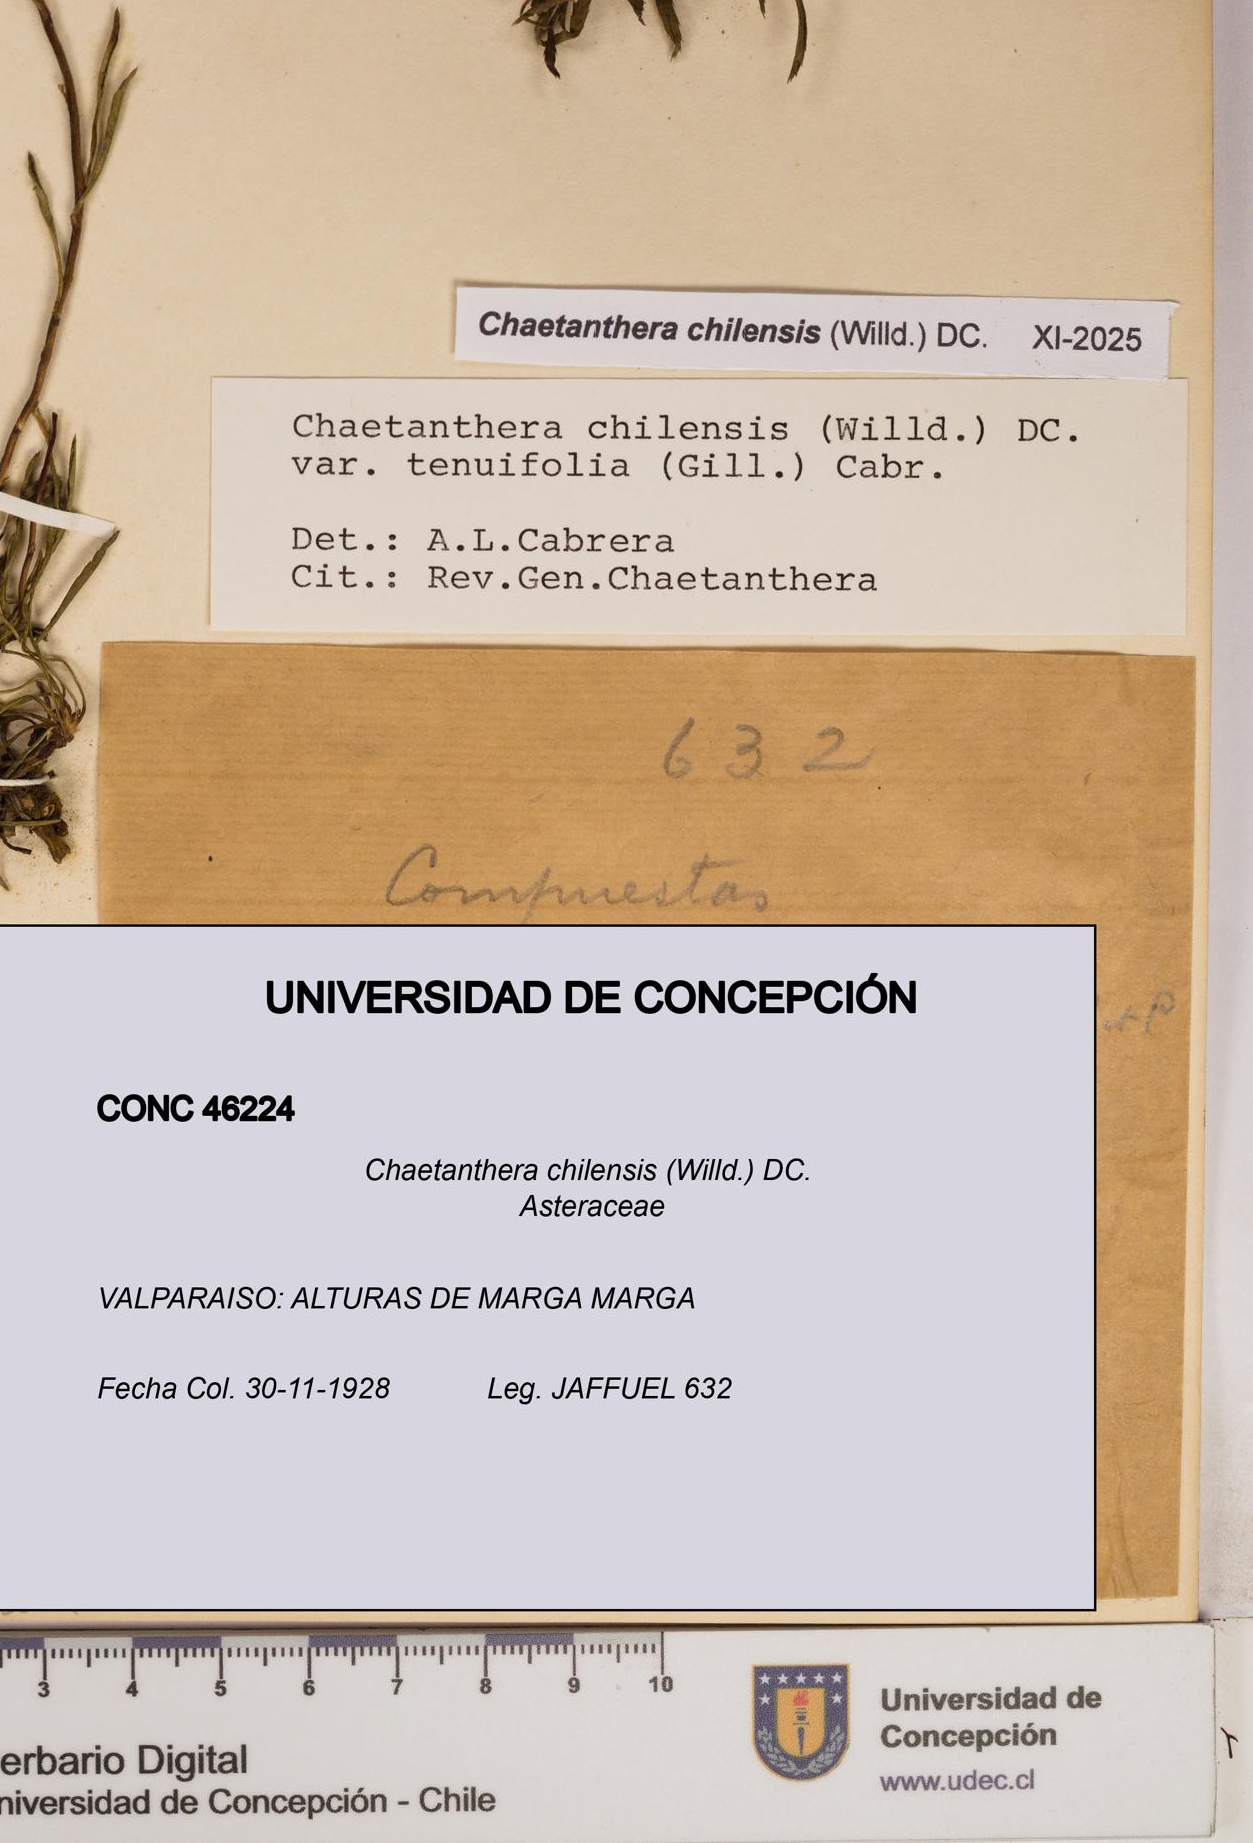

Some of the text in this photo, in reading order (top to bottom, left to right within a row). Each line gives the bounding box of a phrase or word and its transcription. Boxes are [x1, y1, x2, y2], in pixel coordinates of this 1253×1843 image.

[478, 310, 1143, 353] Chaetanthera chilensis (Willd.) DC. XI-2025
[292, 412, 1078, 446] Chaetanthera chilensis (Willd.) DC.
[290, 450, 942, 482] var. tenuifolia (Gill.) Cabr.
[291, 526, 675, 553] Det.: A.L.Cabrera
[291, 563, 878, 592] Cit.: Rev.Gen.Chaetanthera
[37, 1681, 51, 1699] 3
[125, 1681, 139, 1698] 4
[213, 1681, 228, 1698] 5
[302, 1679, 316, 1697] 6
[390, 1678, 404, 1696] 7
[479, 1677, 493, 1695] 8
[567, 1677, 581, 1694] 9
[648, 1676, 674, 1693] 10
[881, 1685, 1103, 1712] Universidad de
[880, 1722, 1057, 1753] Concepción
[138, 1743, 247, 1782] Digital
[879, 1768, 1035, 1792] www.udec.cl
[160, 1788, 199, 1815] de
[208, 1787, 388, 1820] Concepción
[419, 1786, 497, 1813] Chile
